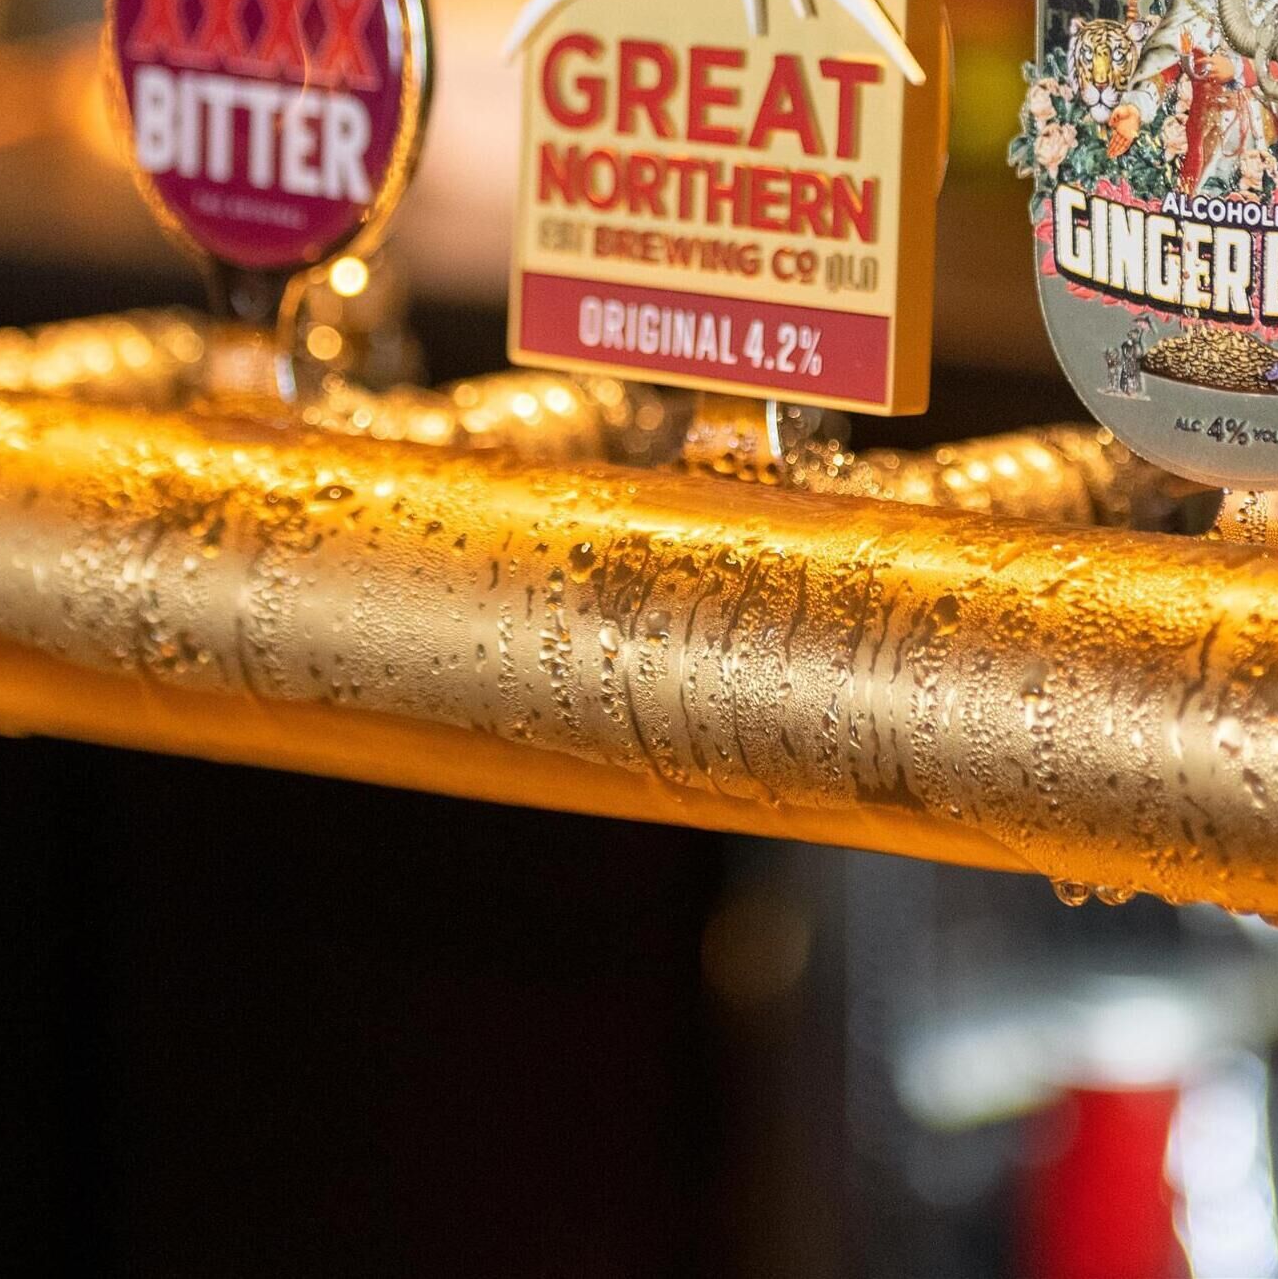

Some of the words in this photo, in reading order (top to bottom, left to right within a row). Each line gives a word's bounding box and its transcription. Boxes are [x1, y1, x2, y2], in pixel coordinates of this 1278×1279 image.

[133, 63, 373, 204] BITTER
[540, 31, 885, 161] GREAT
[538, 142, 881, 244] NORTHERN
[592, 225, 762, 278] BREWING
[1055, 183, 1255, 316] GINGER
[577, 294, 739, 365] ORIGINAL
[742, 316, 824, 378] 4.2%
[1174, 416, 1202, 433] ALC
[1206, 415, 1250, 446] 4%
